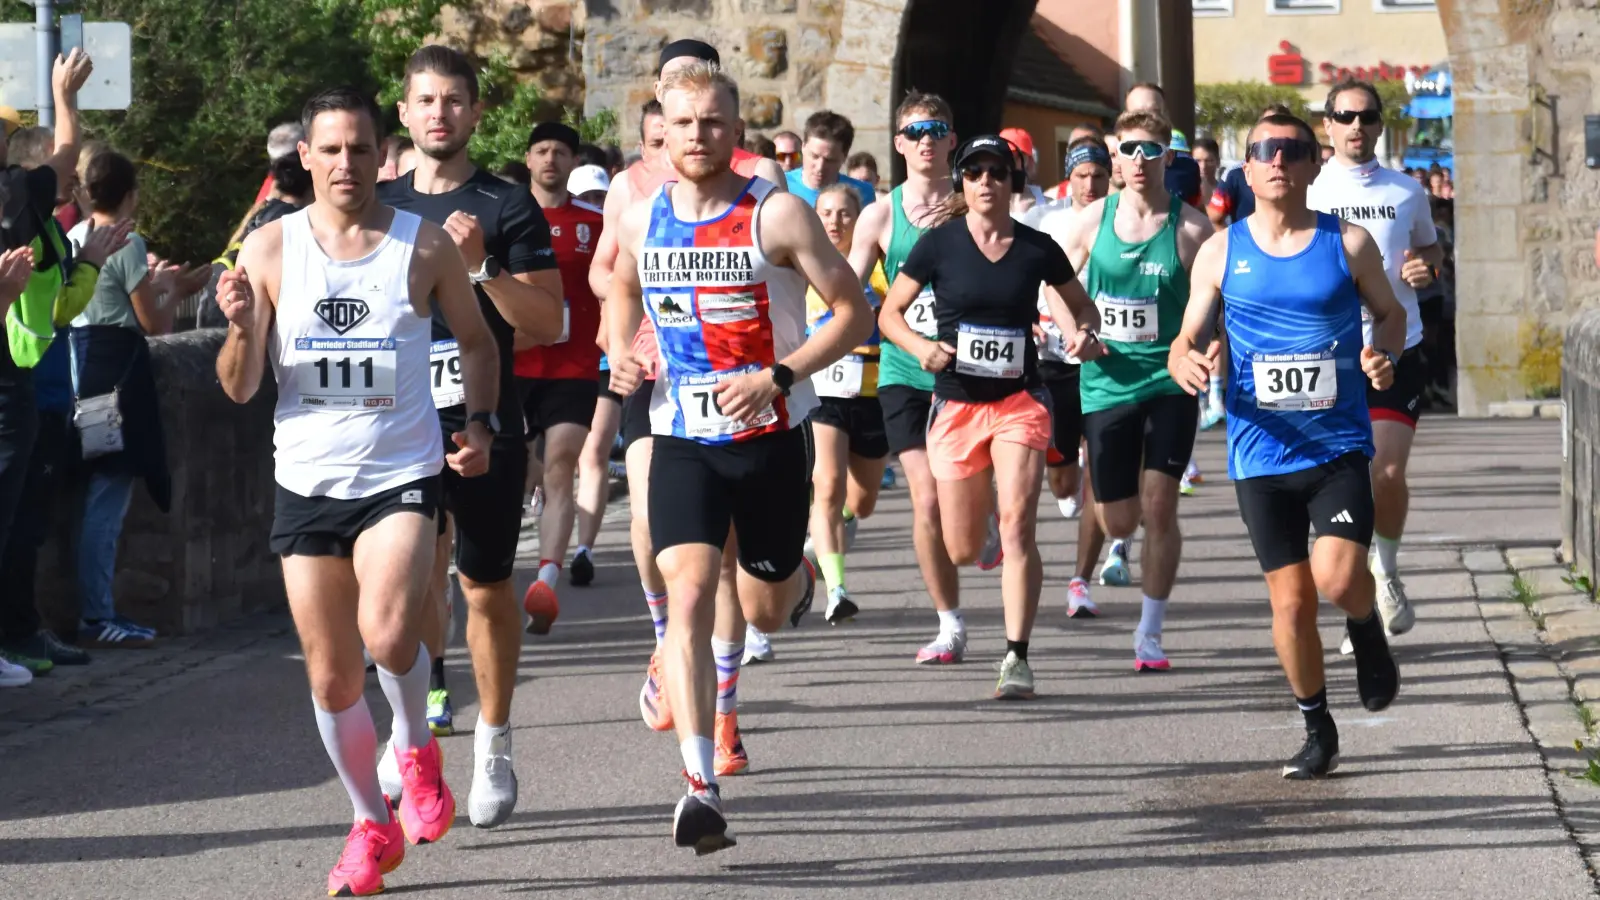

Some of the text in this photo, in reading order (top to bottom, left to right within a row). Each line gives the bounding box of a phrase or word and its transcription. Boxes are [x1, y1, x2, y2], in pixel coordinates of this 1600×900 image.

[643, 250, 752, 270] LA CARRERA
[644, 270, 754, 282] TRITEAM ROTHSEE
[1104, 307, 1146, 328] 515
[311, 340, 380, 349] Herrieder Stadtlauf
[970, 339, 1015, 363] 664
[313, 356, 373, 388] 111
[430, 356, 463, 388] 79
[1267, 366, 1321, 393] 307
